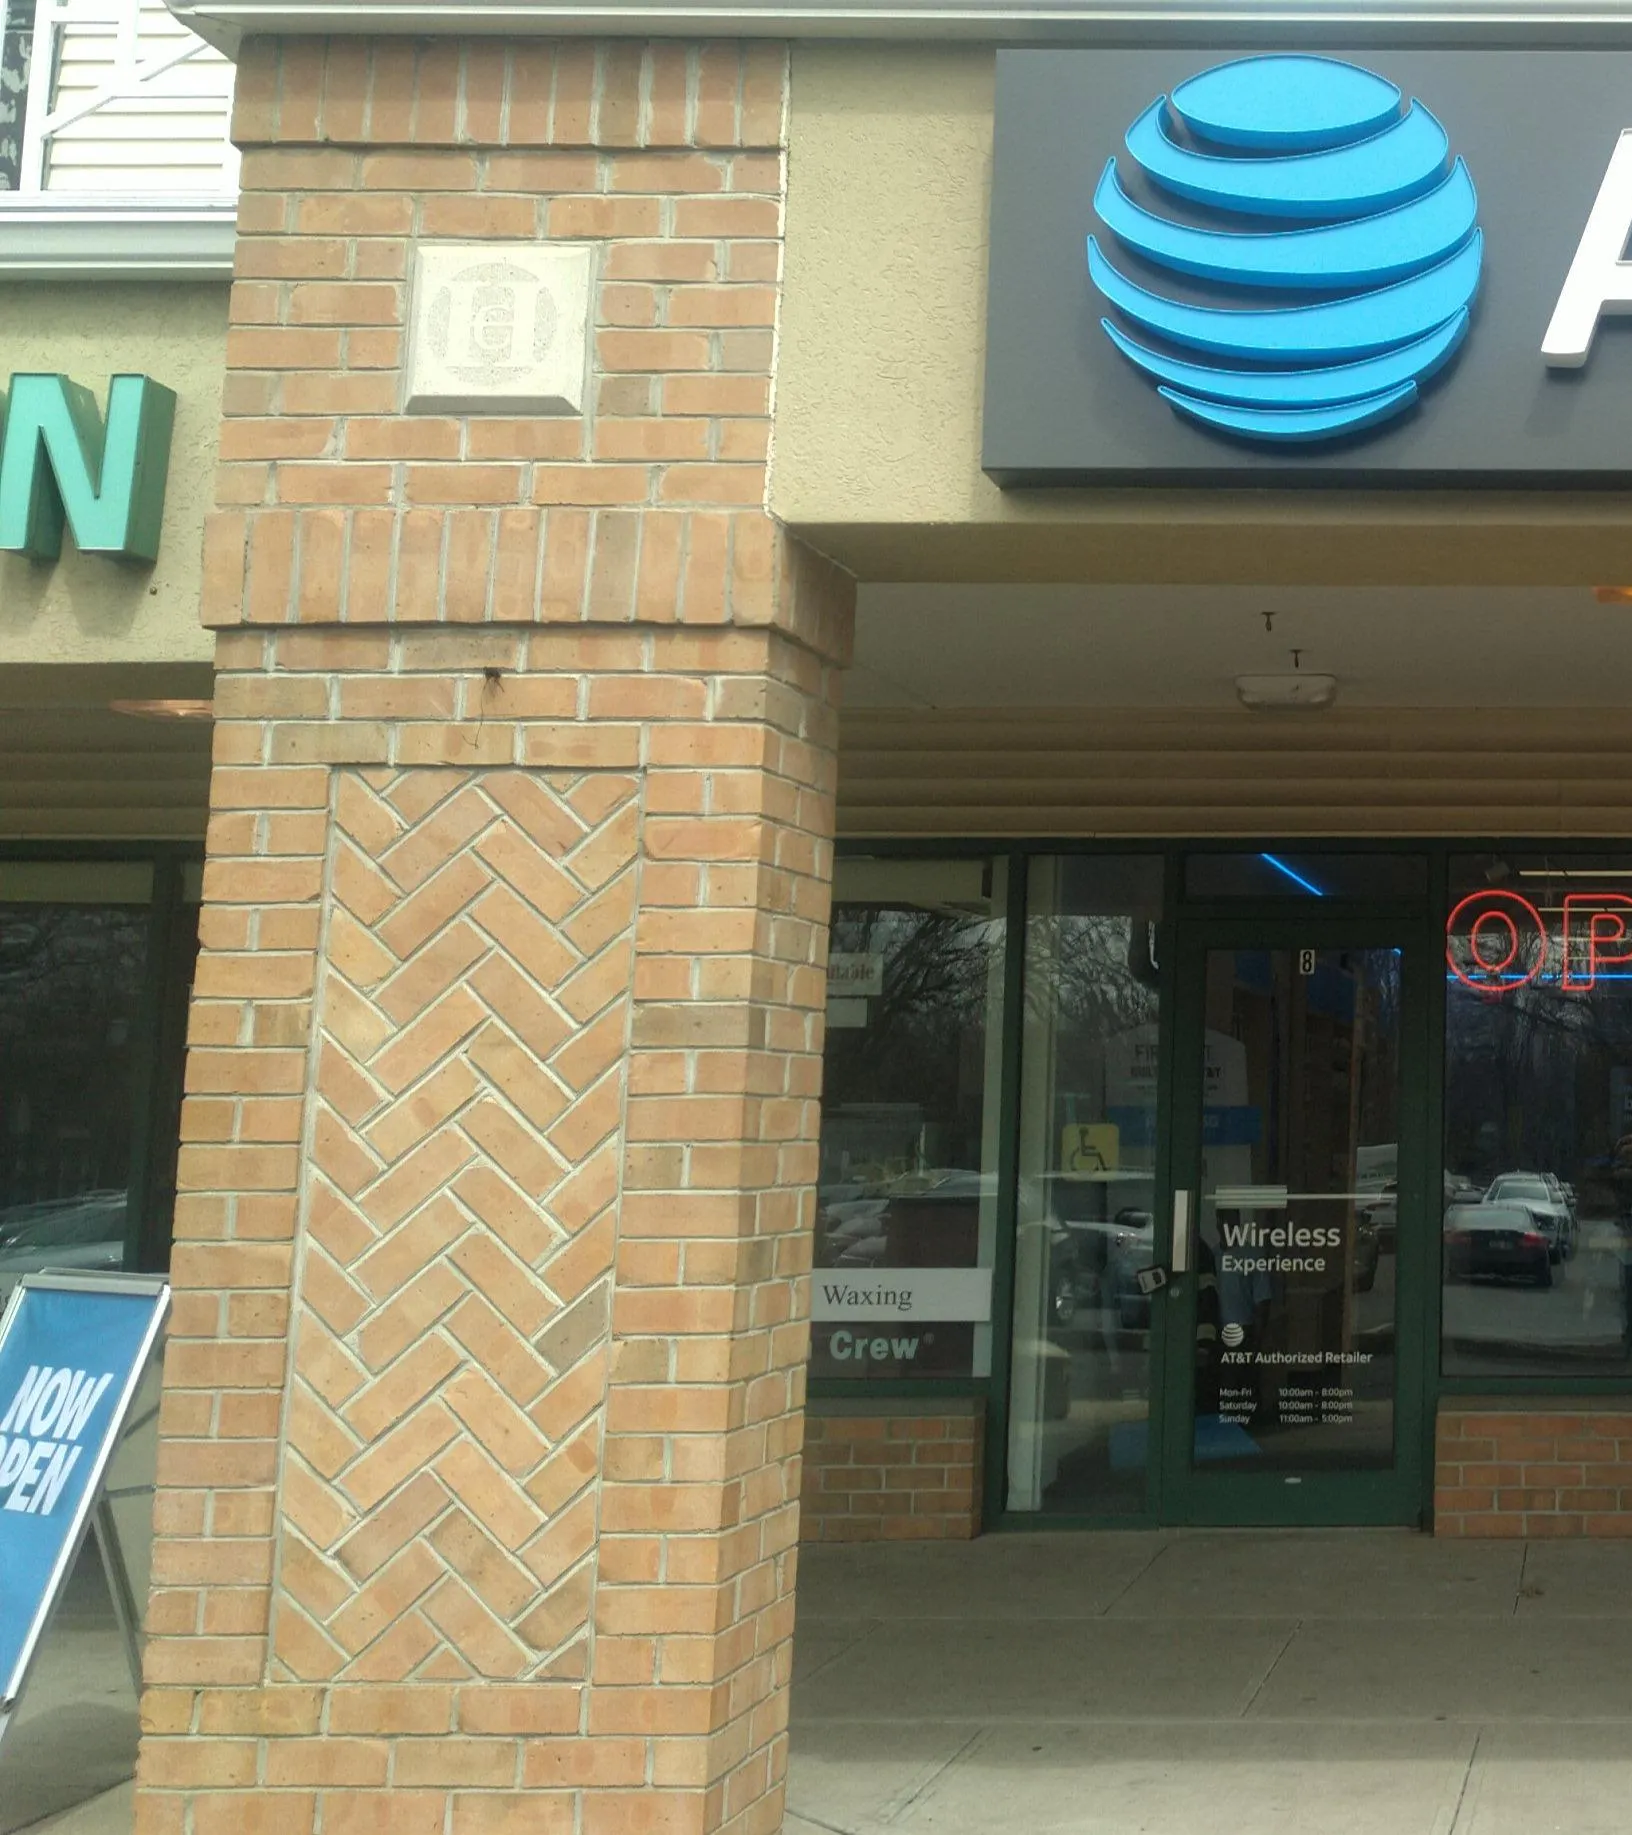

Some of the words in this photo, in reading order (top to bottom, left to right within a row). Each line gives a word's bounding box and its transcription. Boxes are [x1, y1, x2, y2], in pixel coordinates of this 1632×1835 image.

[1302, 951, 1312, 972] 8
[1223, 1221, 1341, 1248] Wireless
[1221, 1253, 1326, 1275] Experience
[822, 1284, 912, 1312] Waxing
[829, 1330, 919, 1361] Crew
[1221, 1351, 1252, 1365] AT&T
[1255, 1350, 1322, 1365] Authorized
[1325, 1350, 1372, 1365] Retailer
[1, 1364, 113, 1441] NOW
[1219, 1401, 1257, 1412] Saturday
[1219, 1414, 1251, 1425] Sunday
[0, 1434, 84, 1516] PEN
